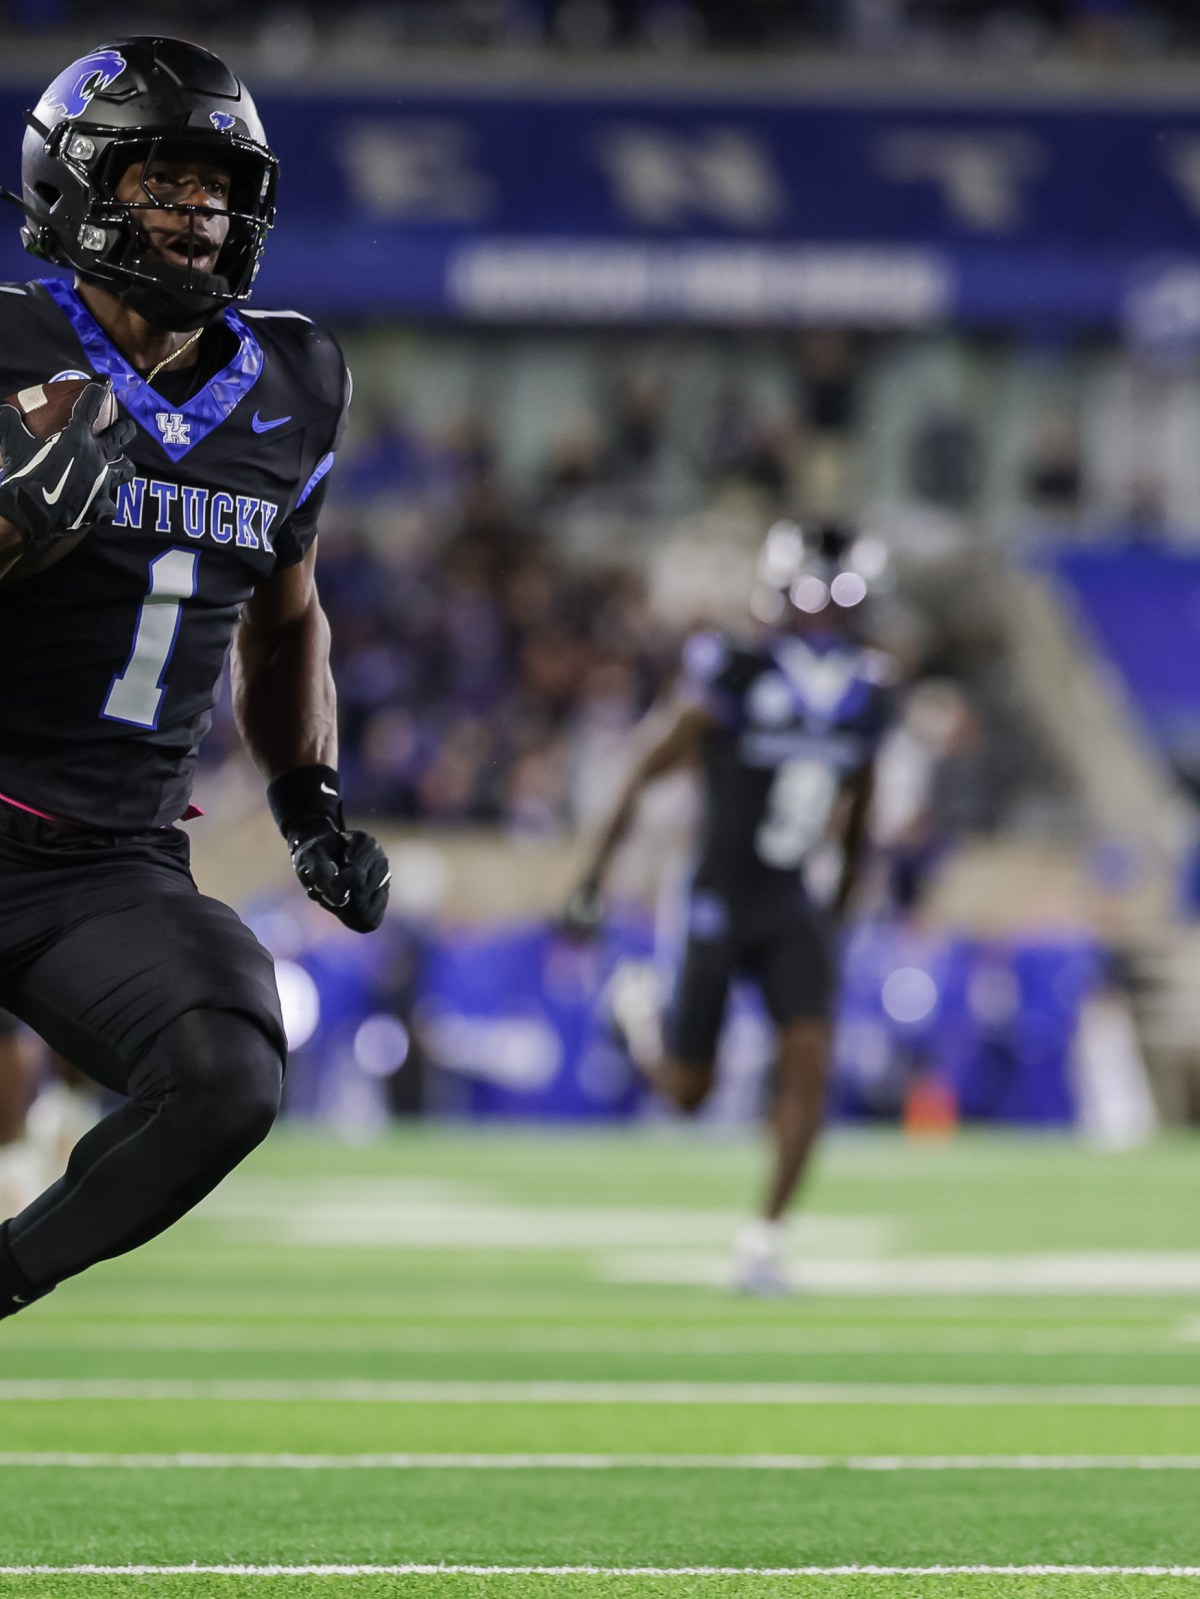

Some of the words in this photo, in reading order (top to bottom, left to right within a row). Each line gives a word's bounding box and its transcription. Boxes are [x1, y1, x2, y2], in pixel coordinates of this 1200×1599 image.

[156, 413, 190, 445] UK
[112, 476, 278, 553] NTUCKY
[99, 545, 202, 731] 1
